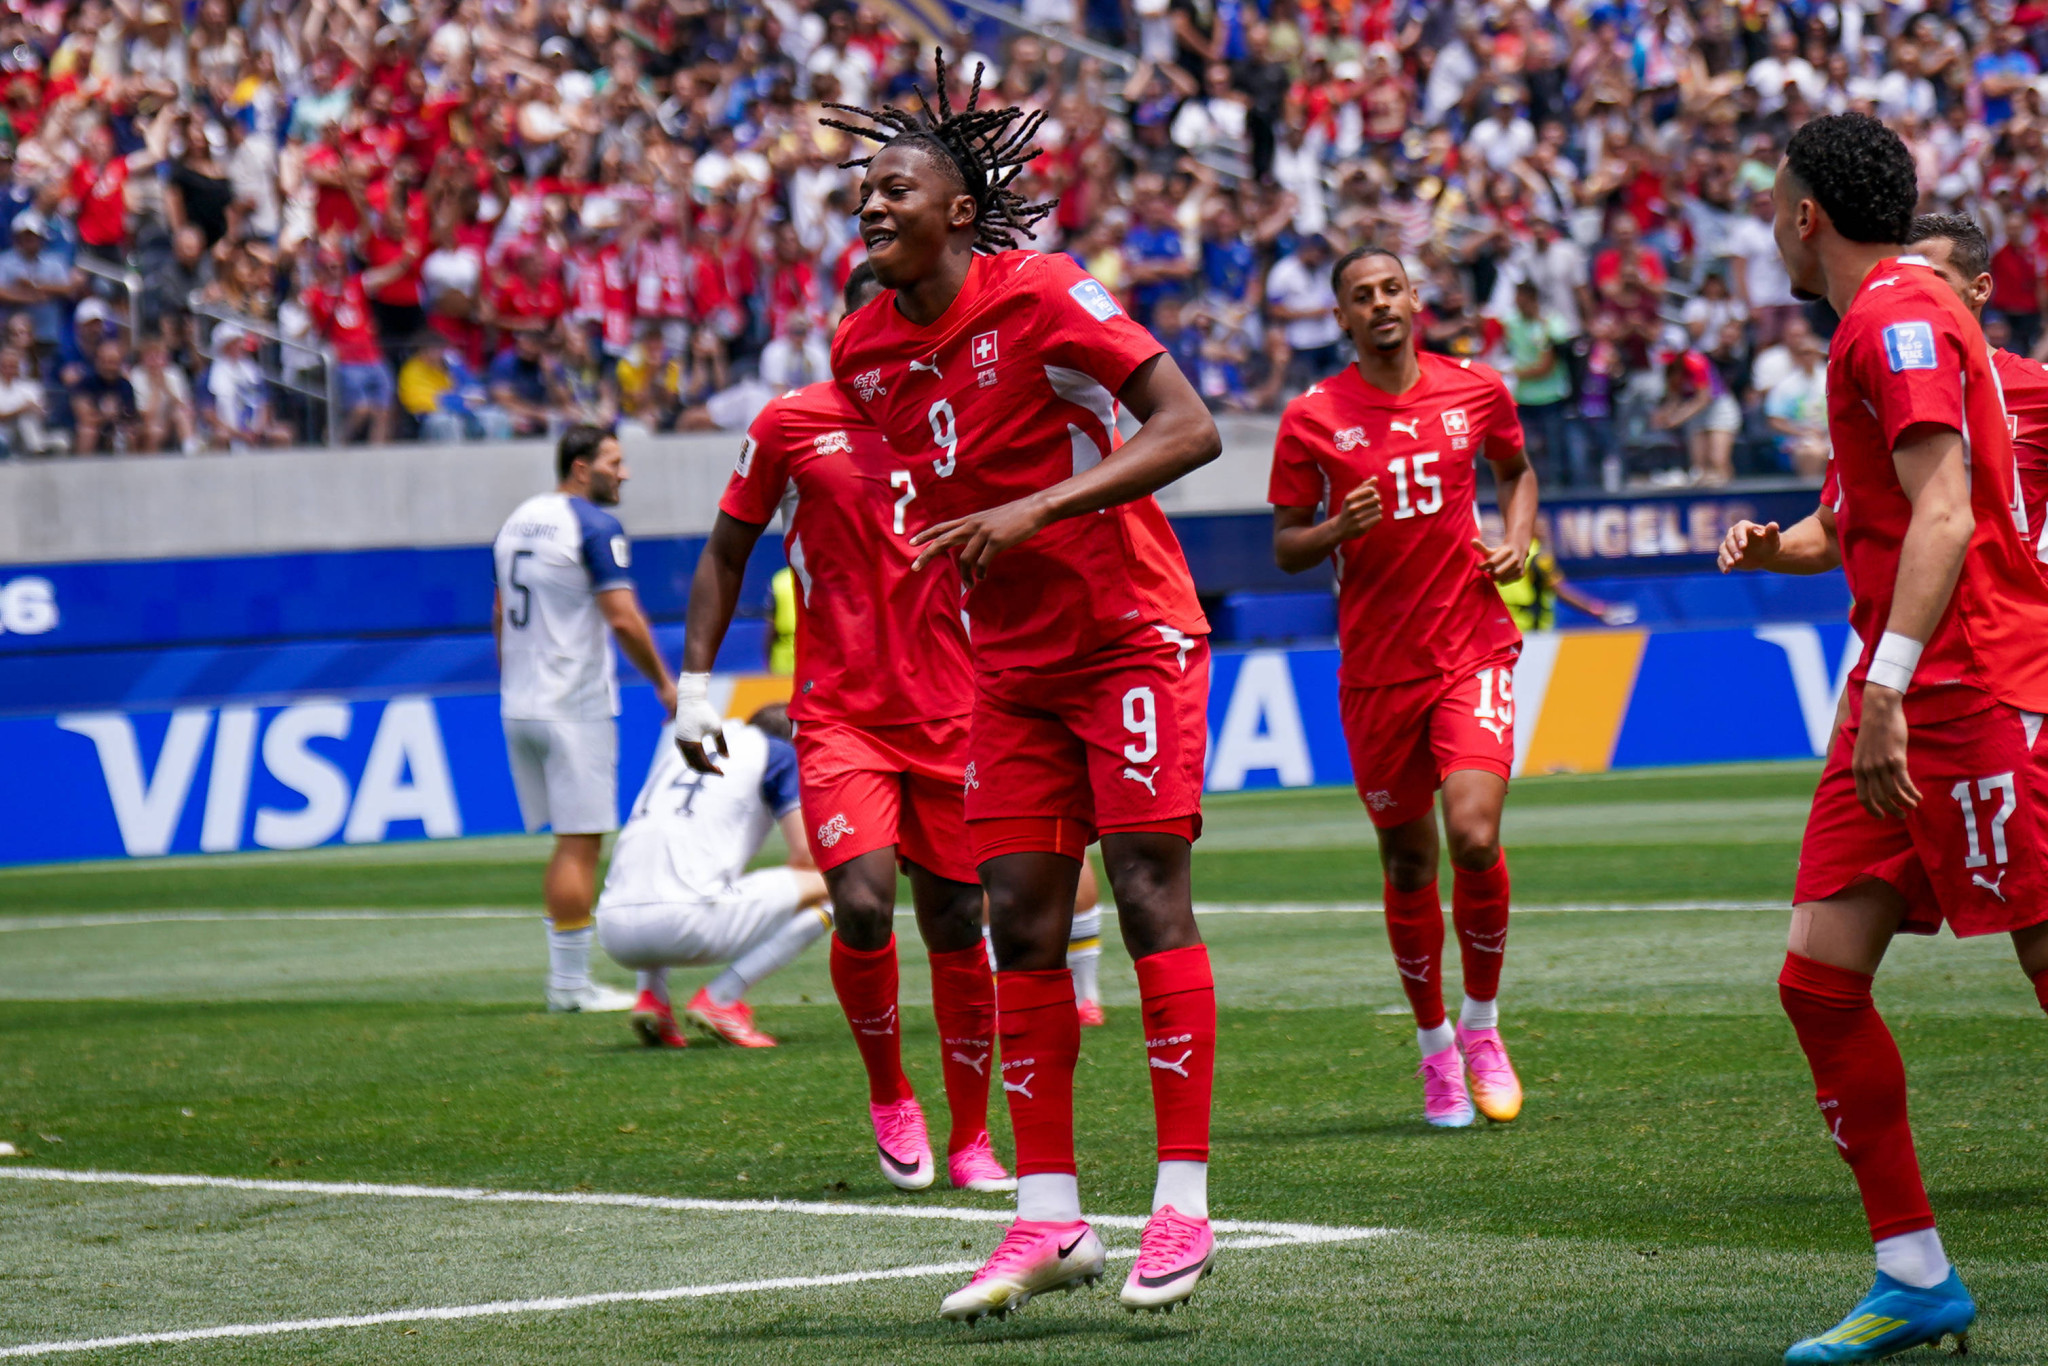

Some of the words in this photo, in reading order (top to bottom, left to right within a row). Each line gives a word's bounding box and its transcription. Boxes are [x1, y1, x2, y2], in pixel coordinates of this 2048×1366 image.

[928, 398, 957, 478] 9
[891, 469, 916, 535] 7
[1387, 451, 1443, 520] 15
[510, 550, 533, 628] 5
[1122, 686, 1157, 763] 9
[56, 694, 464, 859] VISA
[1951, 771, 2017, 868] 17
